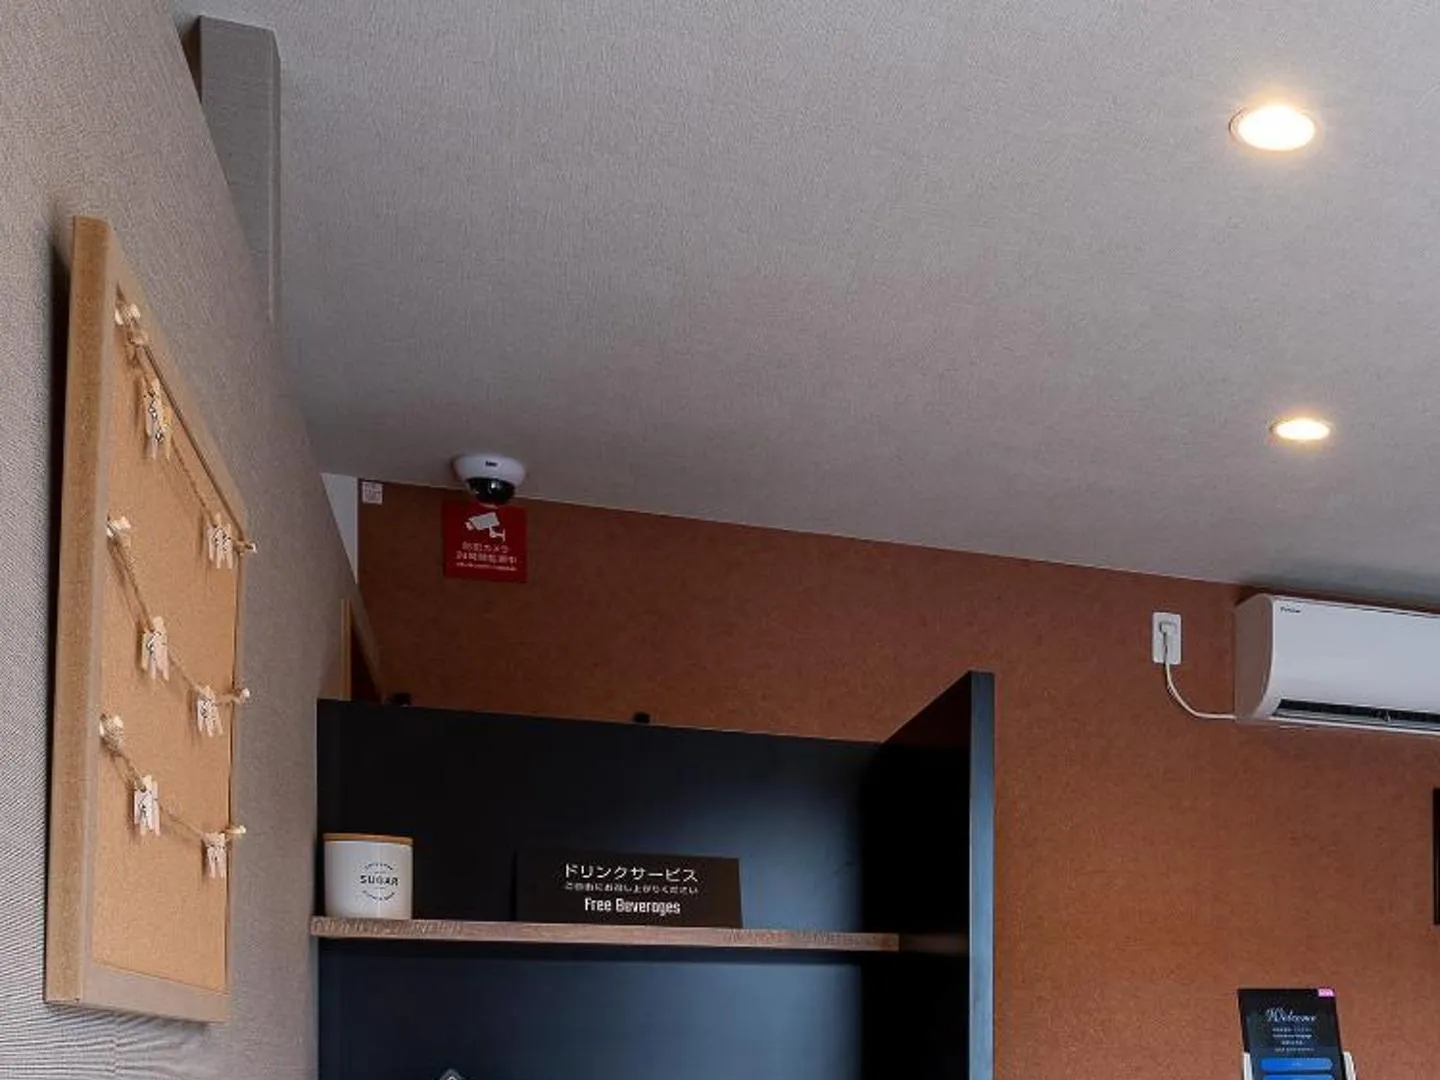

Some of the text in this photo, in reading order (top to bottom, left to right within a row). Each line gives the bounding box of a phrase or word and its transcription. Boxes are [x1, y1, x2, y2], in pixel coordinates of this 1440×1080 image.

[360, 875, 398, 886] SUGAR
[565, 863, 698, 882] ドリンクサービス
[584, 897, 681, 916] Free Beverages
[1266, 1007, 1317, 1023] Welcome
